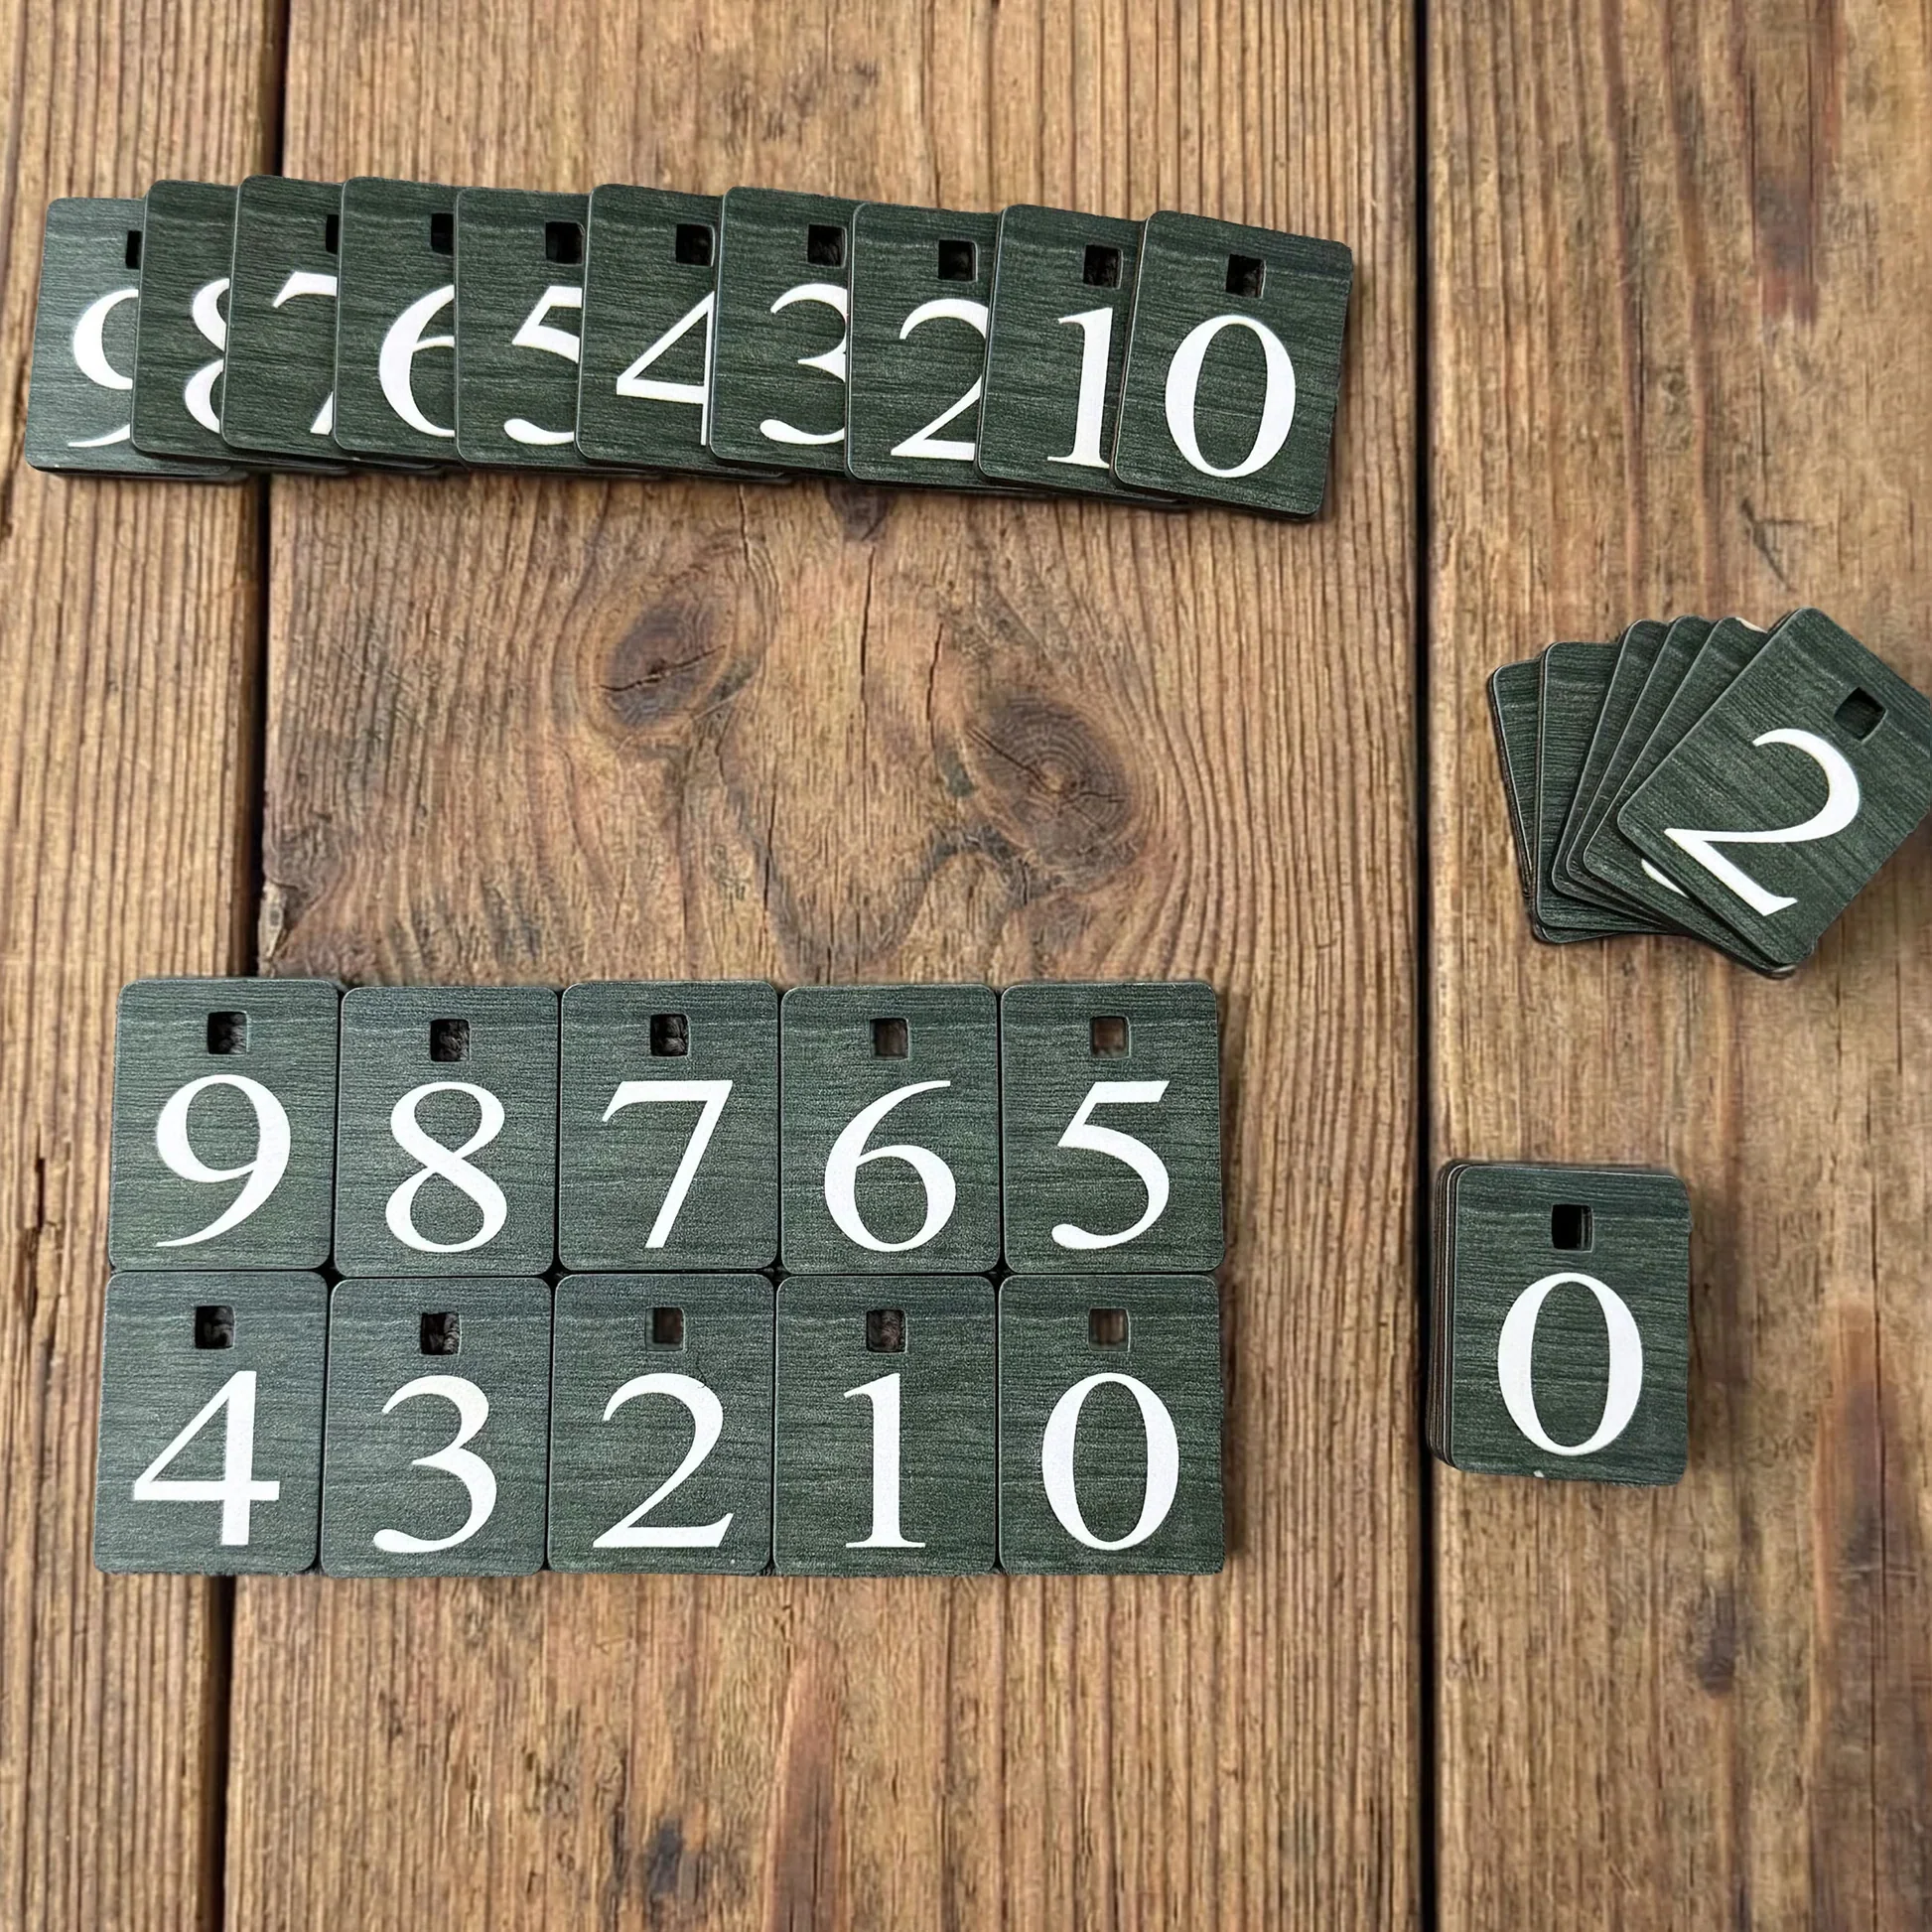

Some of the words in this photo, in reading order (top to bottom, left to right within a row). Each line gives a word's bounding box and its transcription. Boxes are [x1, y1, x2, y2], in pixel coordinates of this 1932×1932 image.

[65, 285, 140, 449] 9
[377, 284, 456, 438] 6
[503, 285, 583, 446] 5
[616, 290, 716, 446] 4
[759, 282, 849, 445] 3
[890, 298, 989, 461] 2
[1046, 307, 1114, 469] 1
[1165, 314, 1297, 479] 0
[1663, 727, 1861, 916] 2
[150, 1073, 292, 1248] 9
[384, 1080, 508, 1254] 8
[600, 1079, 734, 1249] 7
[823, 1079, 957, 1253] 6
[1050, 1079, 1171, 1251] 5
[1497, 1272, 1644, 1456] 0
[125, 1369, 281, 1547] 4
[371, 1374, 497, 1556] 3
[592, 1372, 735, 1549] 2
[843, 1372, 926, 1549] 1
[1040, 1372, 1179, 1551] 0
